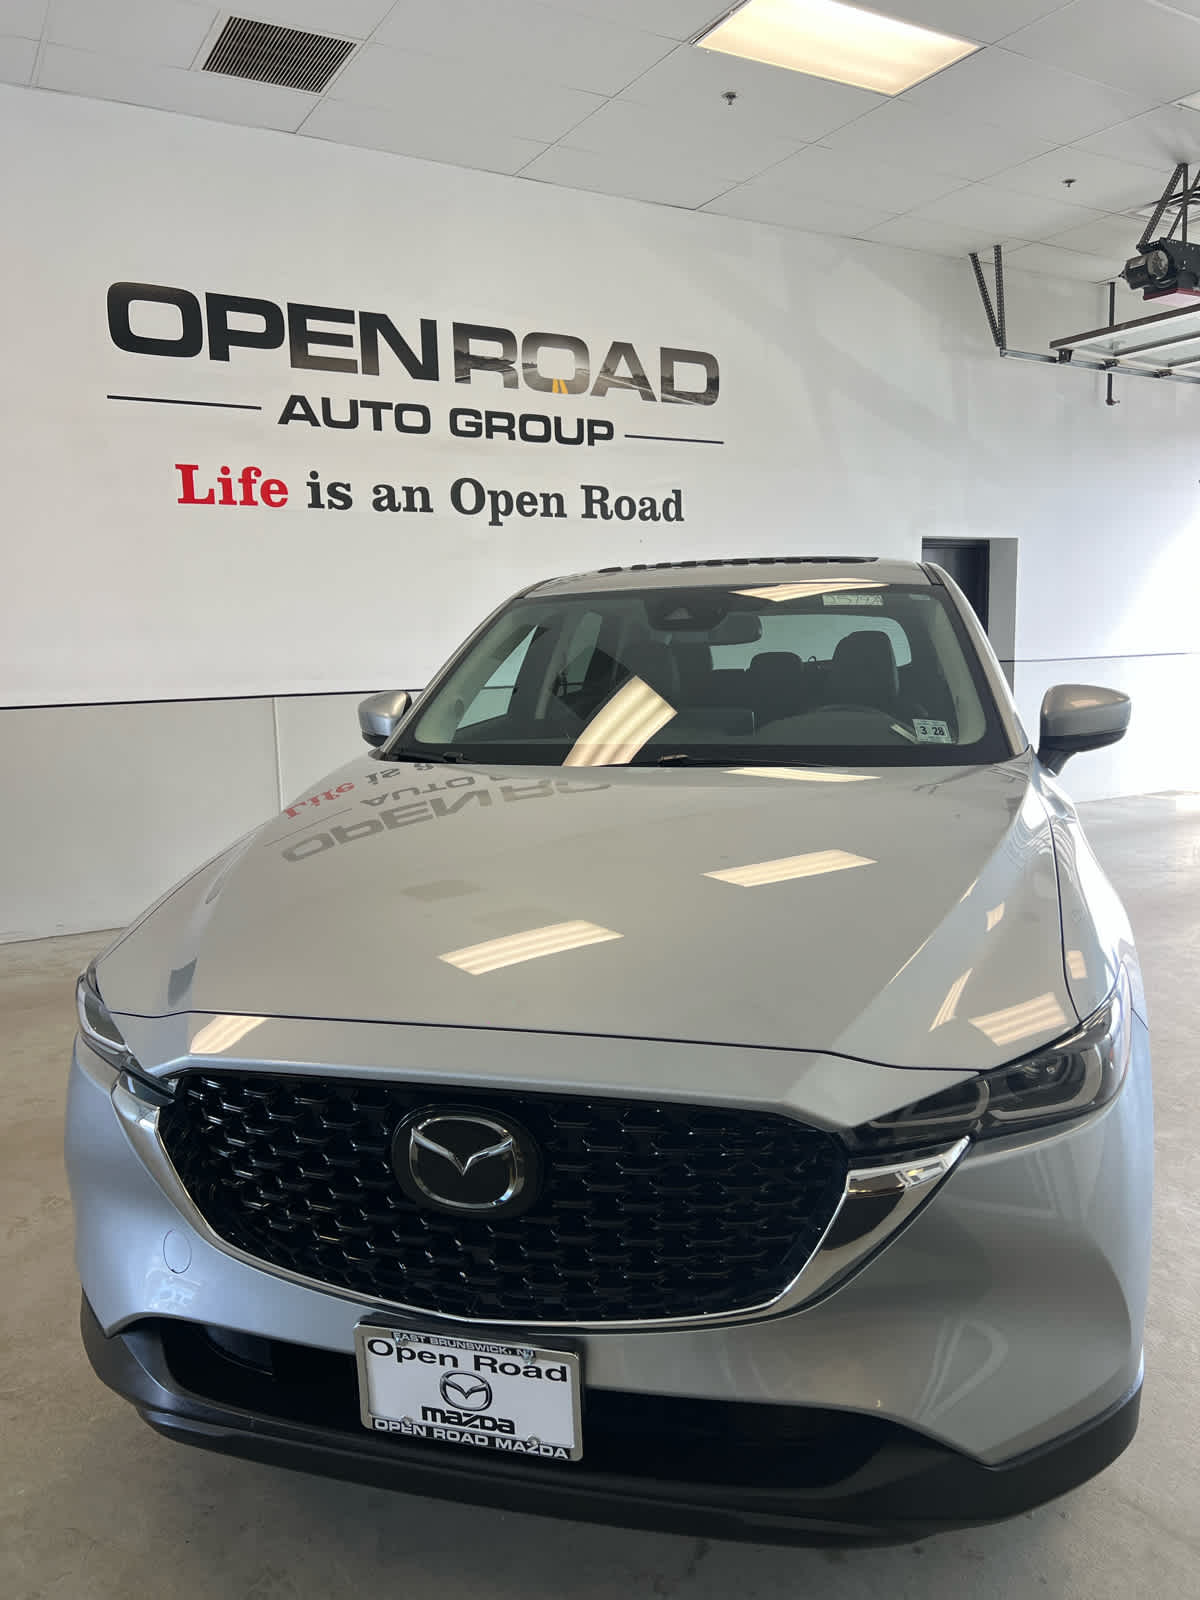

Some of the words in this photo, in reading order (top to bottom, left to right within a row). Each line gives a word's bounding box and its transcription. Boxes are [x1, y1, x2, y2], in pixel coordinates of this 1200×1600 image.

[107, 281, 440, 381] OPEN
[452, 321, 720, 406] ROAD
[277, 394, 431, 434] AUTO
[449, 407, 614, 446] GROUP
[175, 463, 288, 508] Life
[306, 470, 353, 510] is
[372, 482, 433, 513] an
[450, 477, 567, 526] Open
[580, 484, 684, 522] Road
[919, 726, 928, 735] 3
[932, 727, 945, 736] 28
[367, 1339, 458, 1368] Open
[473, 1354, 567, 1382] Road
[391, 1330, 425, 1343] EAST
[430, 1336, 512, 1356] BRUNSWICK,
[374, 1418, 427, 1437] OPEN
[433, 1428, 489, 1446] ROAD
[495, 1437, 568, 1459] MAZDA
